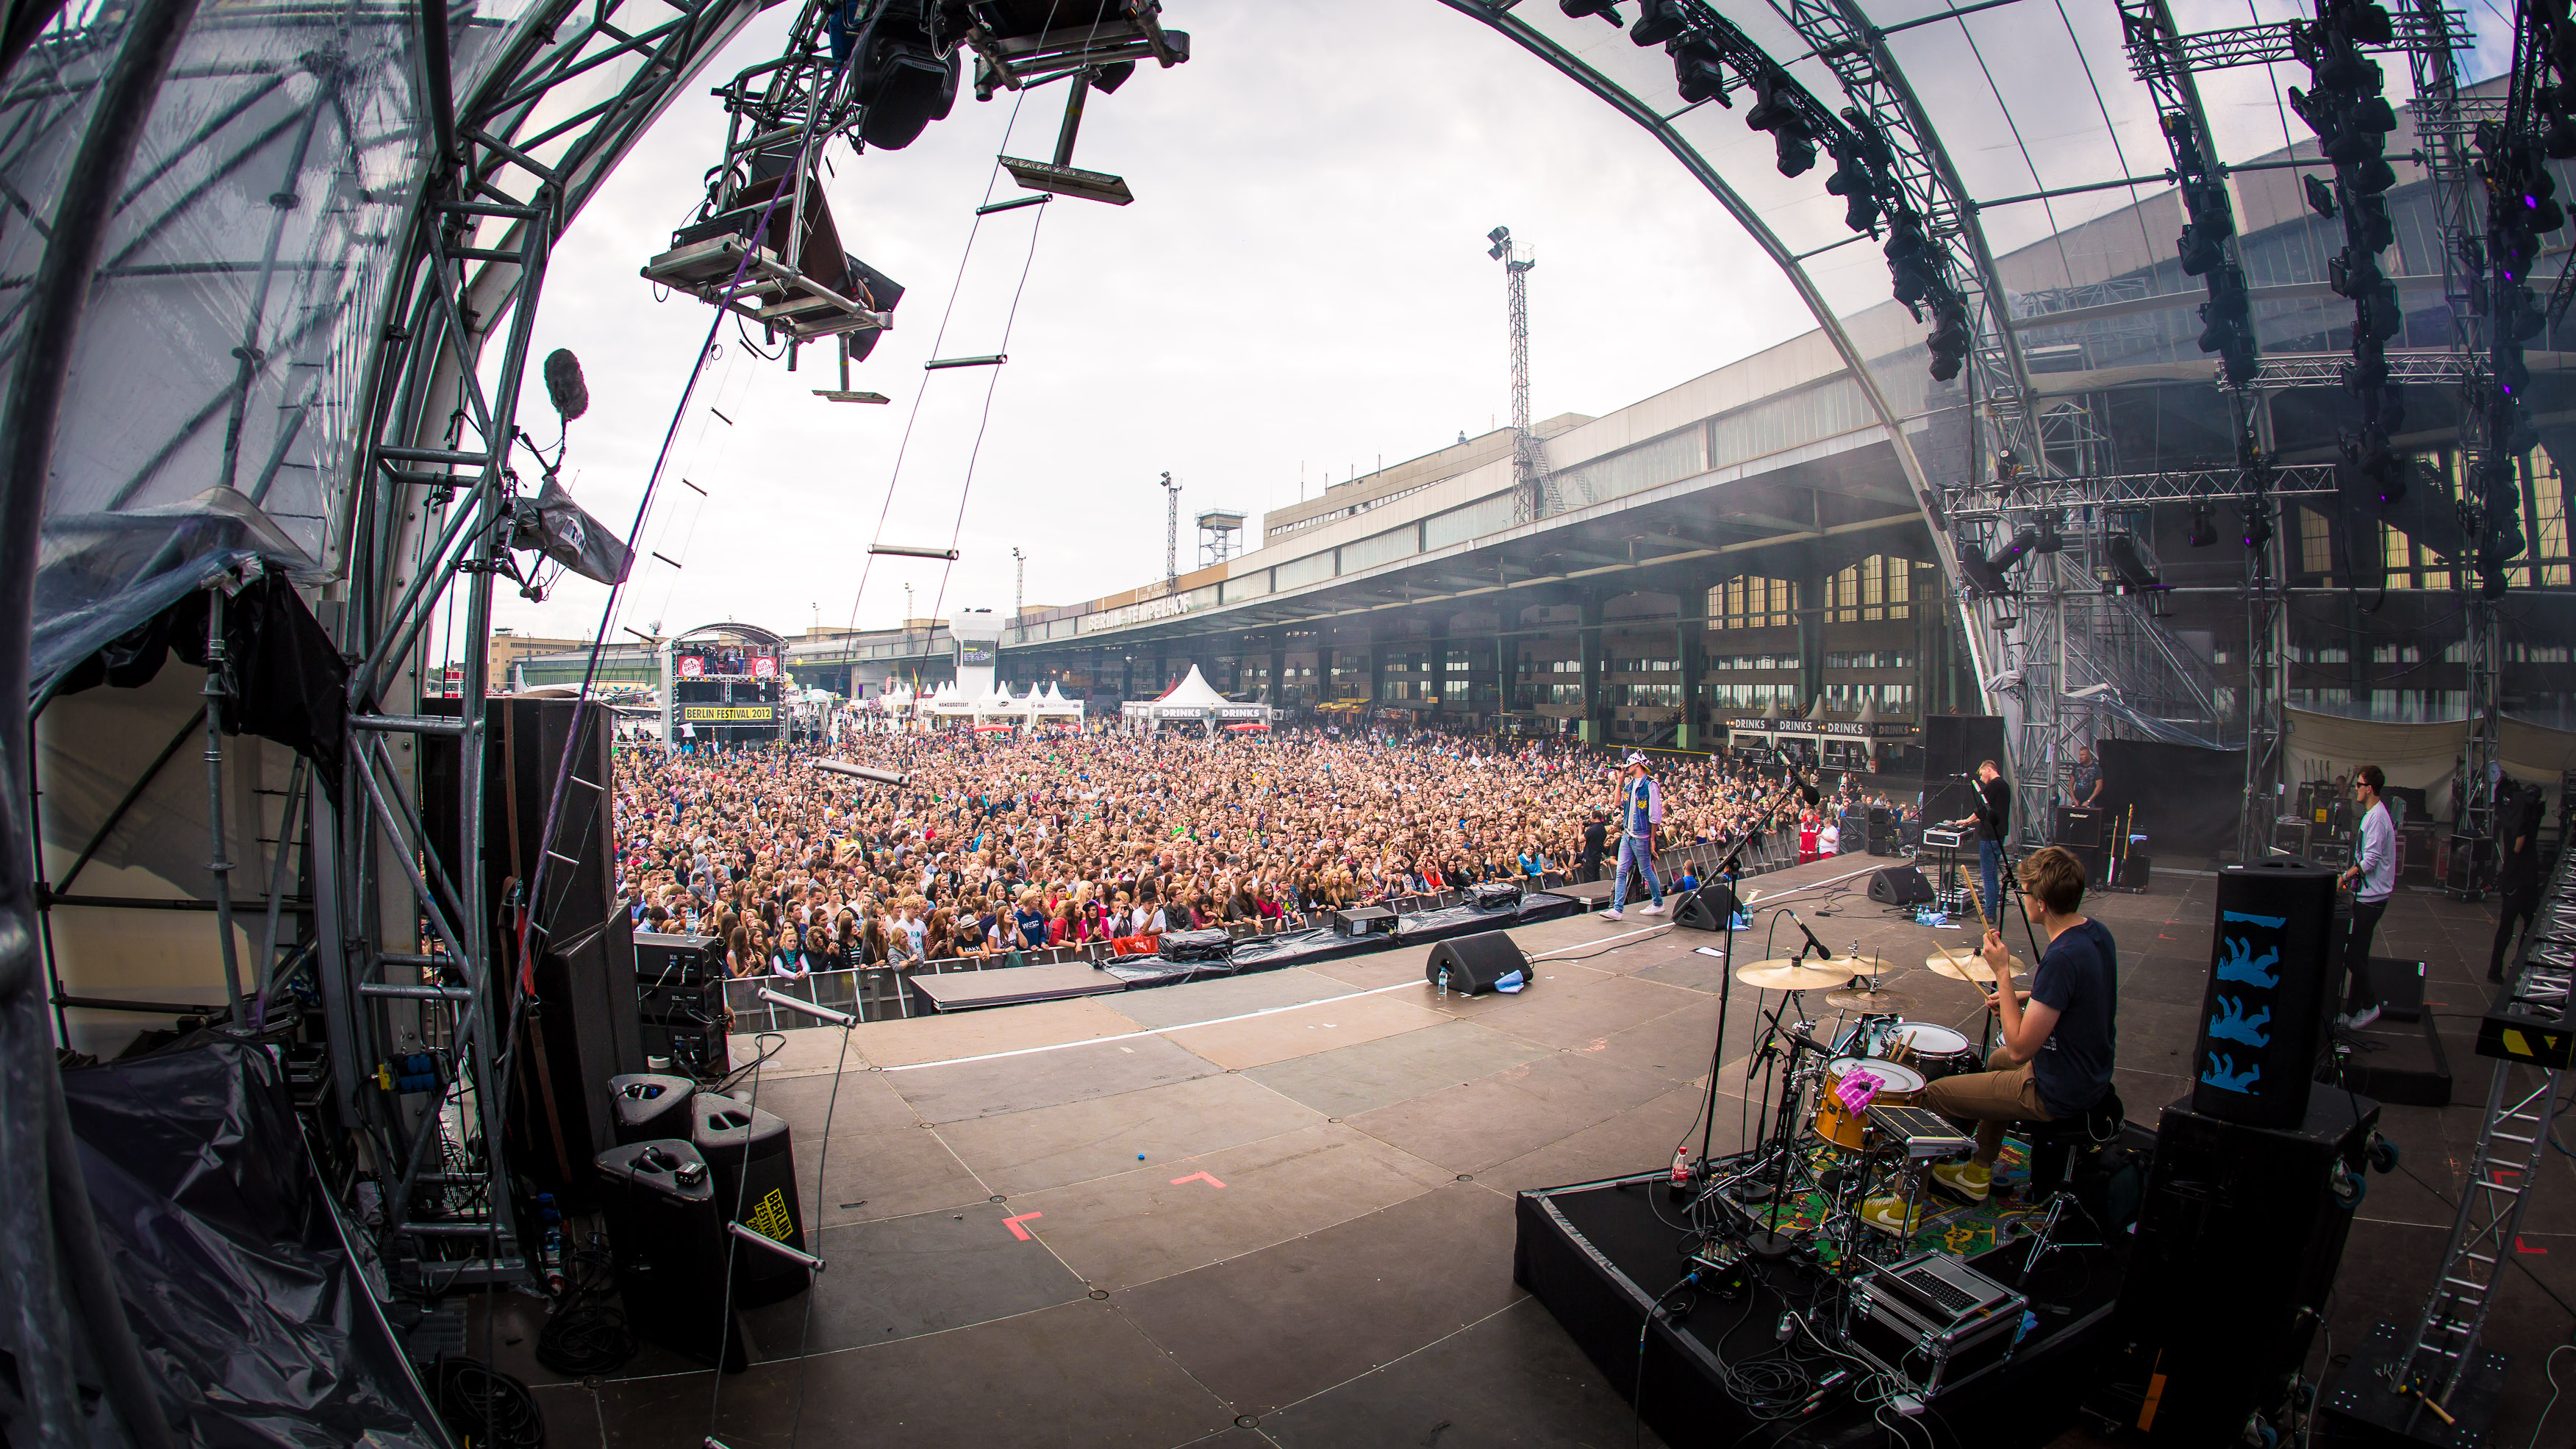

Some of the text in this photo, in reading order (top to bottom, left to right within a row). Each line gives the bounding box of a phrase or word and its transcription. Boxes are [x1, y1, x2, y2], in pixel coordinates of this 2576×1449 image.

[684, 660, 693, 668] hot
[684, 664, 701, 673] seats
[757, 665, 774, 673] seats
[687, 708, 770, 718] BERLIN FESTIVAL 2012
[1162, 709, 1201, 718] DRINKS
[1222, 709, 1260, 718] DRINKS
[1735, 719, 1765, 729] DRINKS
[1779, 720, 1812, 731] DRINKS
[1828, 723, 1863, 734] DRINKS
[1878, 724, 1909, 735] DRINKS
[766, 1189, 792, 1237] BERLIN
